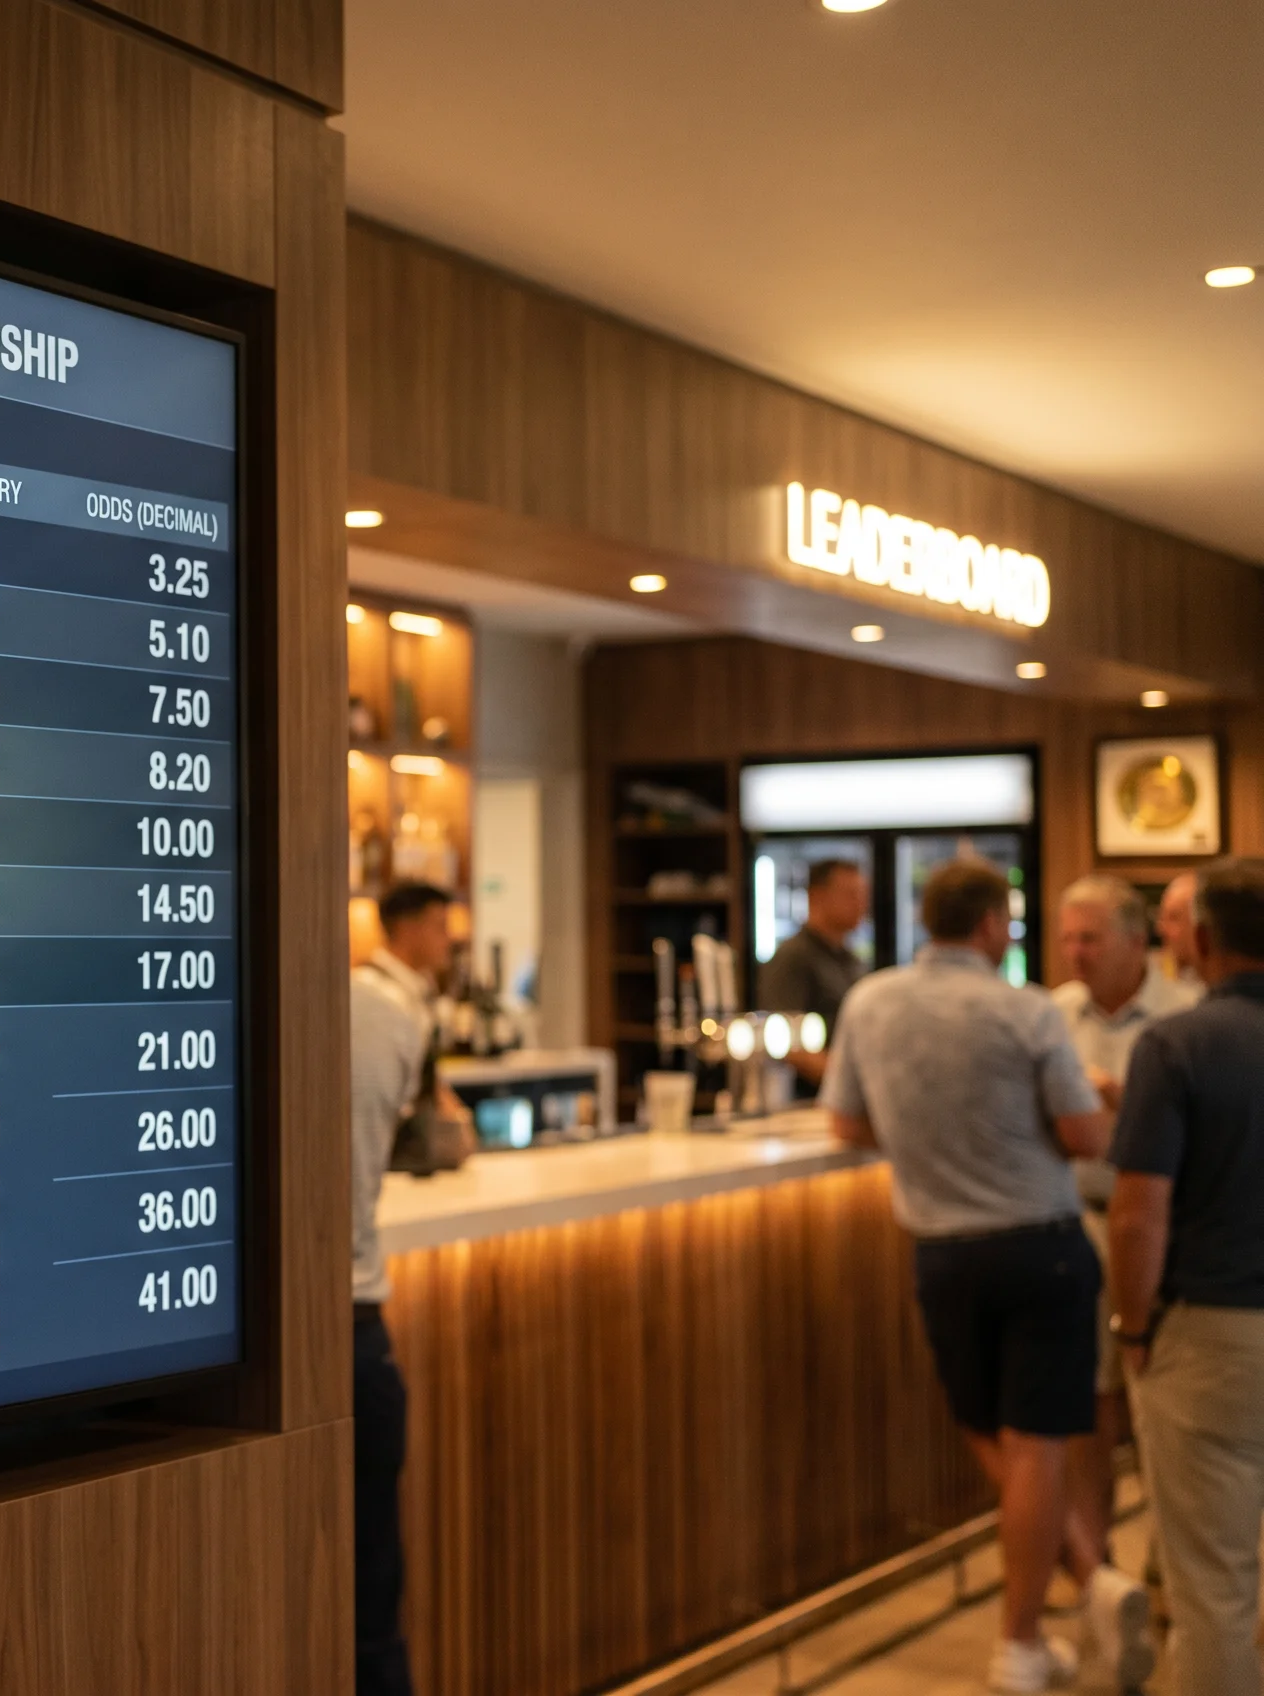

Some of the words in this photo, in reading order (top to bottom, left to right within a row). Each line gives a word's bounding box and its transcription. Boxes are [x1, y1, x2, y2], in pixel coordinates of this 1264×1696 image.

[86, 492, 133, 523] ODDS
[137, 501, 218, 543] (DECIMAL)
[148, 553, 210, 599] 3.25
[786, 481, 1051, 628] LEADERBOARD
[149, 619, 210, 663] 5.10
[148, 684, 211, 728] 7.50
[149, 750, 211, 793] 8.20
[137, 816, 214, 858] 10.00
[137, 883, 215, 924] 14.50
[137, 950, 215, 990] 17.00
[137, 1029, 216, 1072] 21.00
[137, 1107, 216, 1152] 26.00
[138, 1186, 217, 1233] 36.00
[138, 1264, 218, 1313] 41.00
